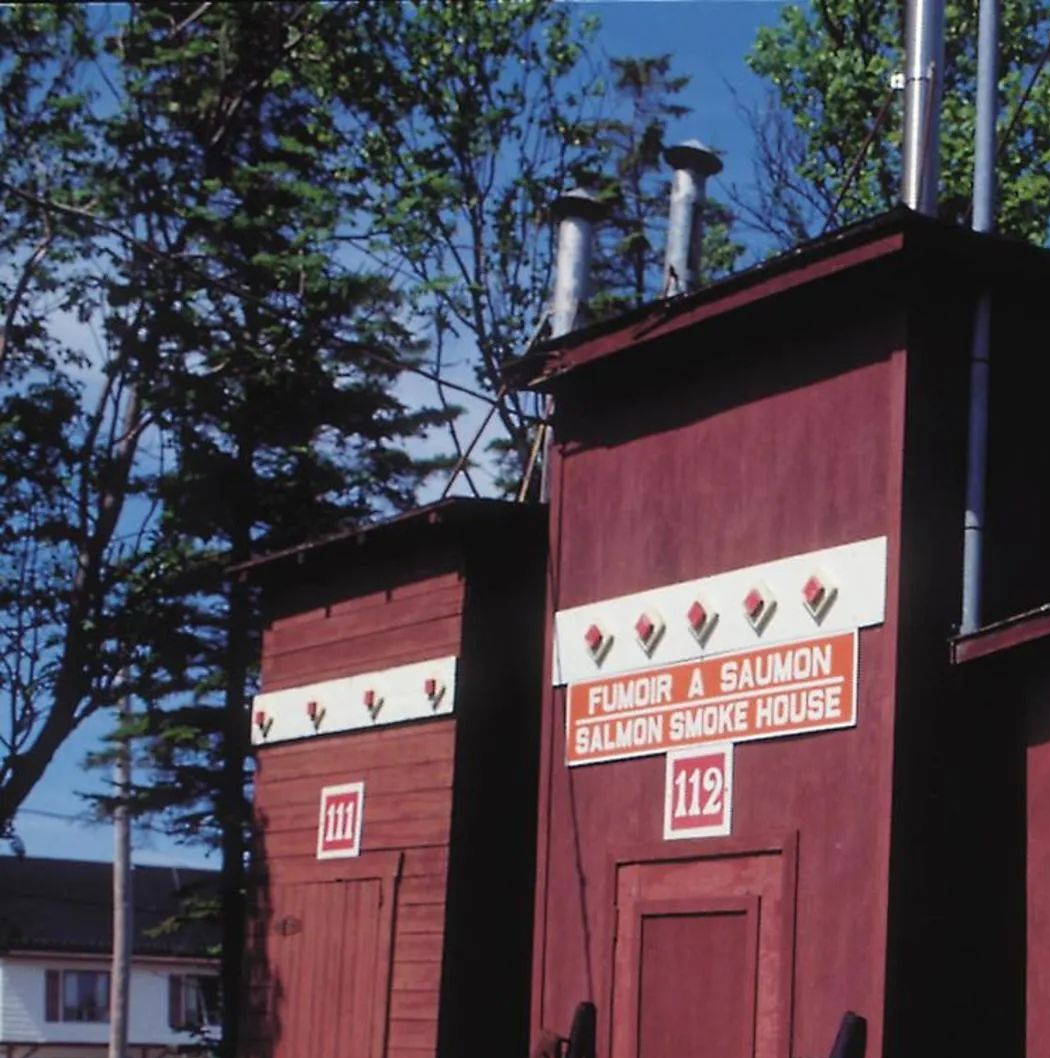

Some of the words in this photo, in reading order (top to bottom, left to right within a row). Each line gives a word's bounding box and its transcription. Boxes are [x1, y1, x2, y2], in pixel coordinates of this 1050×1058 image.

[588, 673, 672, 715] FUMOIR
[688, 669, 704, 697] A
[720, 644, 832, 693] SAUMON
[575, 715, 663, 754] SALMON
[670, 700, 748, 741] SMOKE
[756, 686, 841, 728] HOUSE
[325, 801, 354, 842] 111
[673, 766, 722, 818] 112
